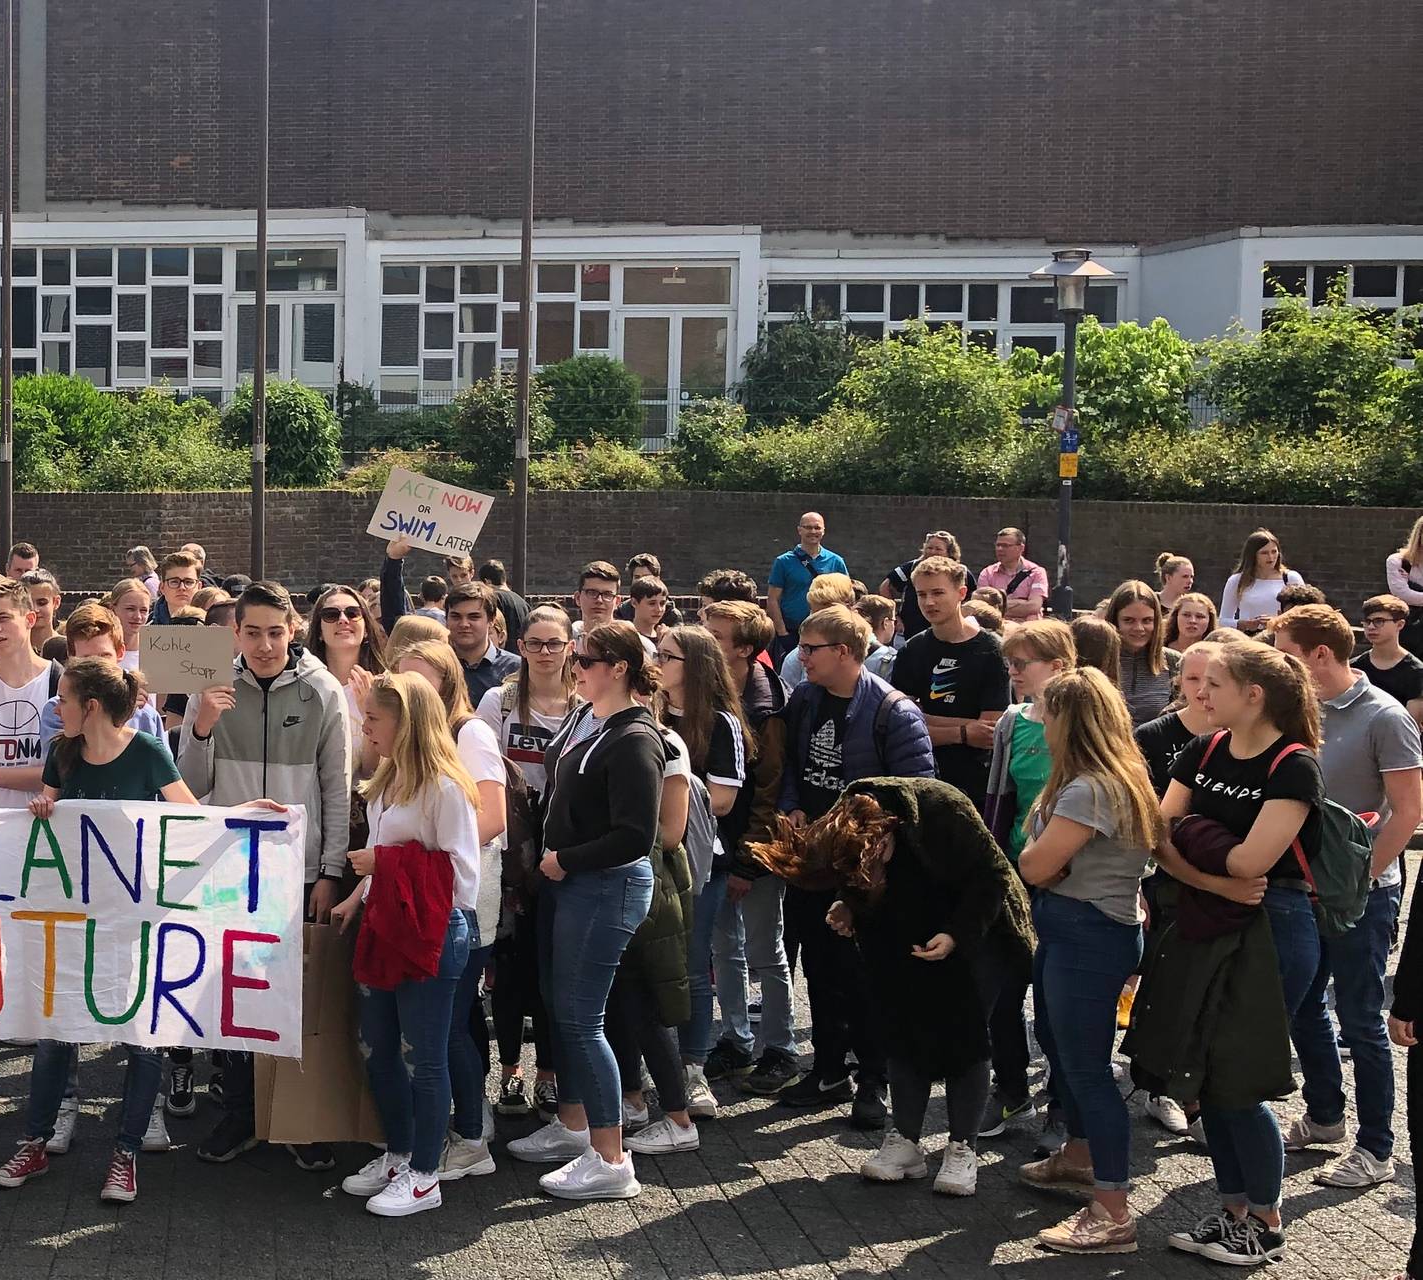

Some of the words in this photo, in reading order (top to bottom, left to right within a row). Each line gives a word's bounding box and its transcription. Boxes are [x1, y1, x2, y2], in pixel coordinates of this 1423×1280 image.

[399, 480, 439, 499] ACT
[441, 492, 483, 514] NOW
[418, 504, 431, 514] OR
[380, 511, 436, 541] SWIM
[436, 534, 472, 552] LATER
[149, 636, 191, 652] Kohle
[180, 660, 216, 679] Stopp
